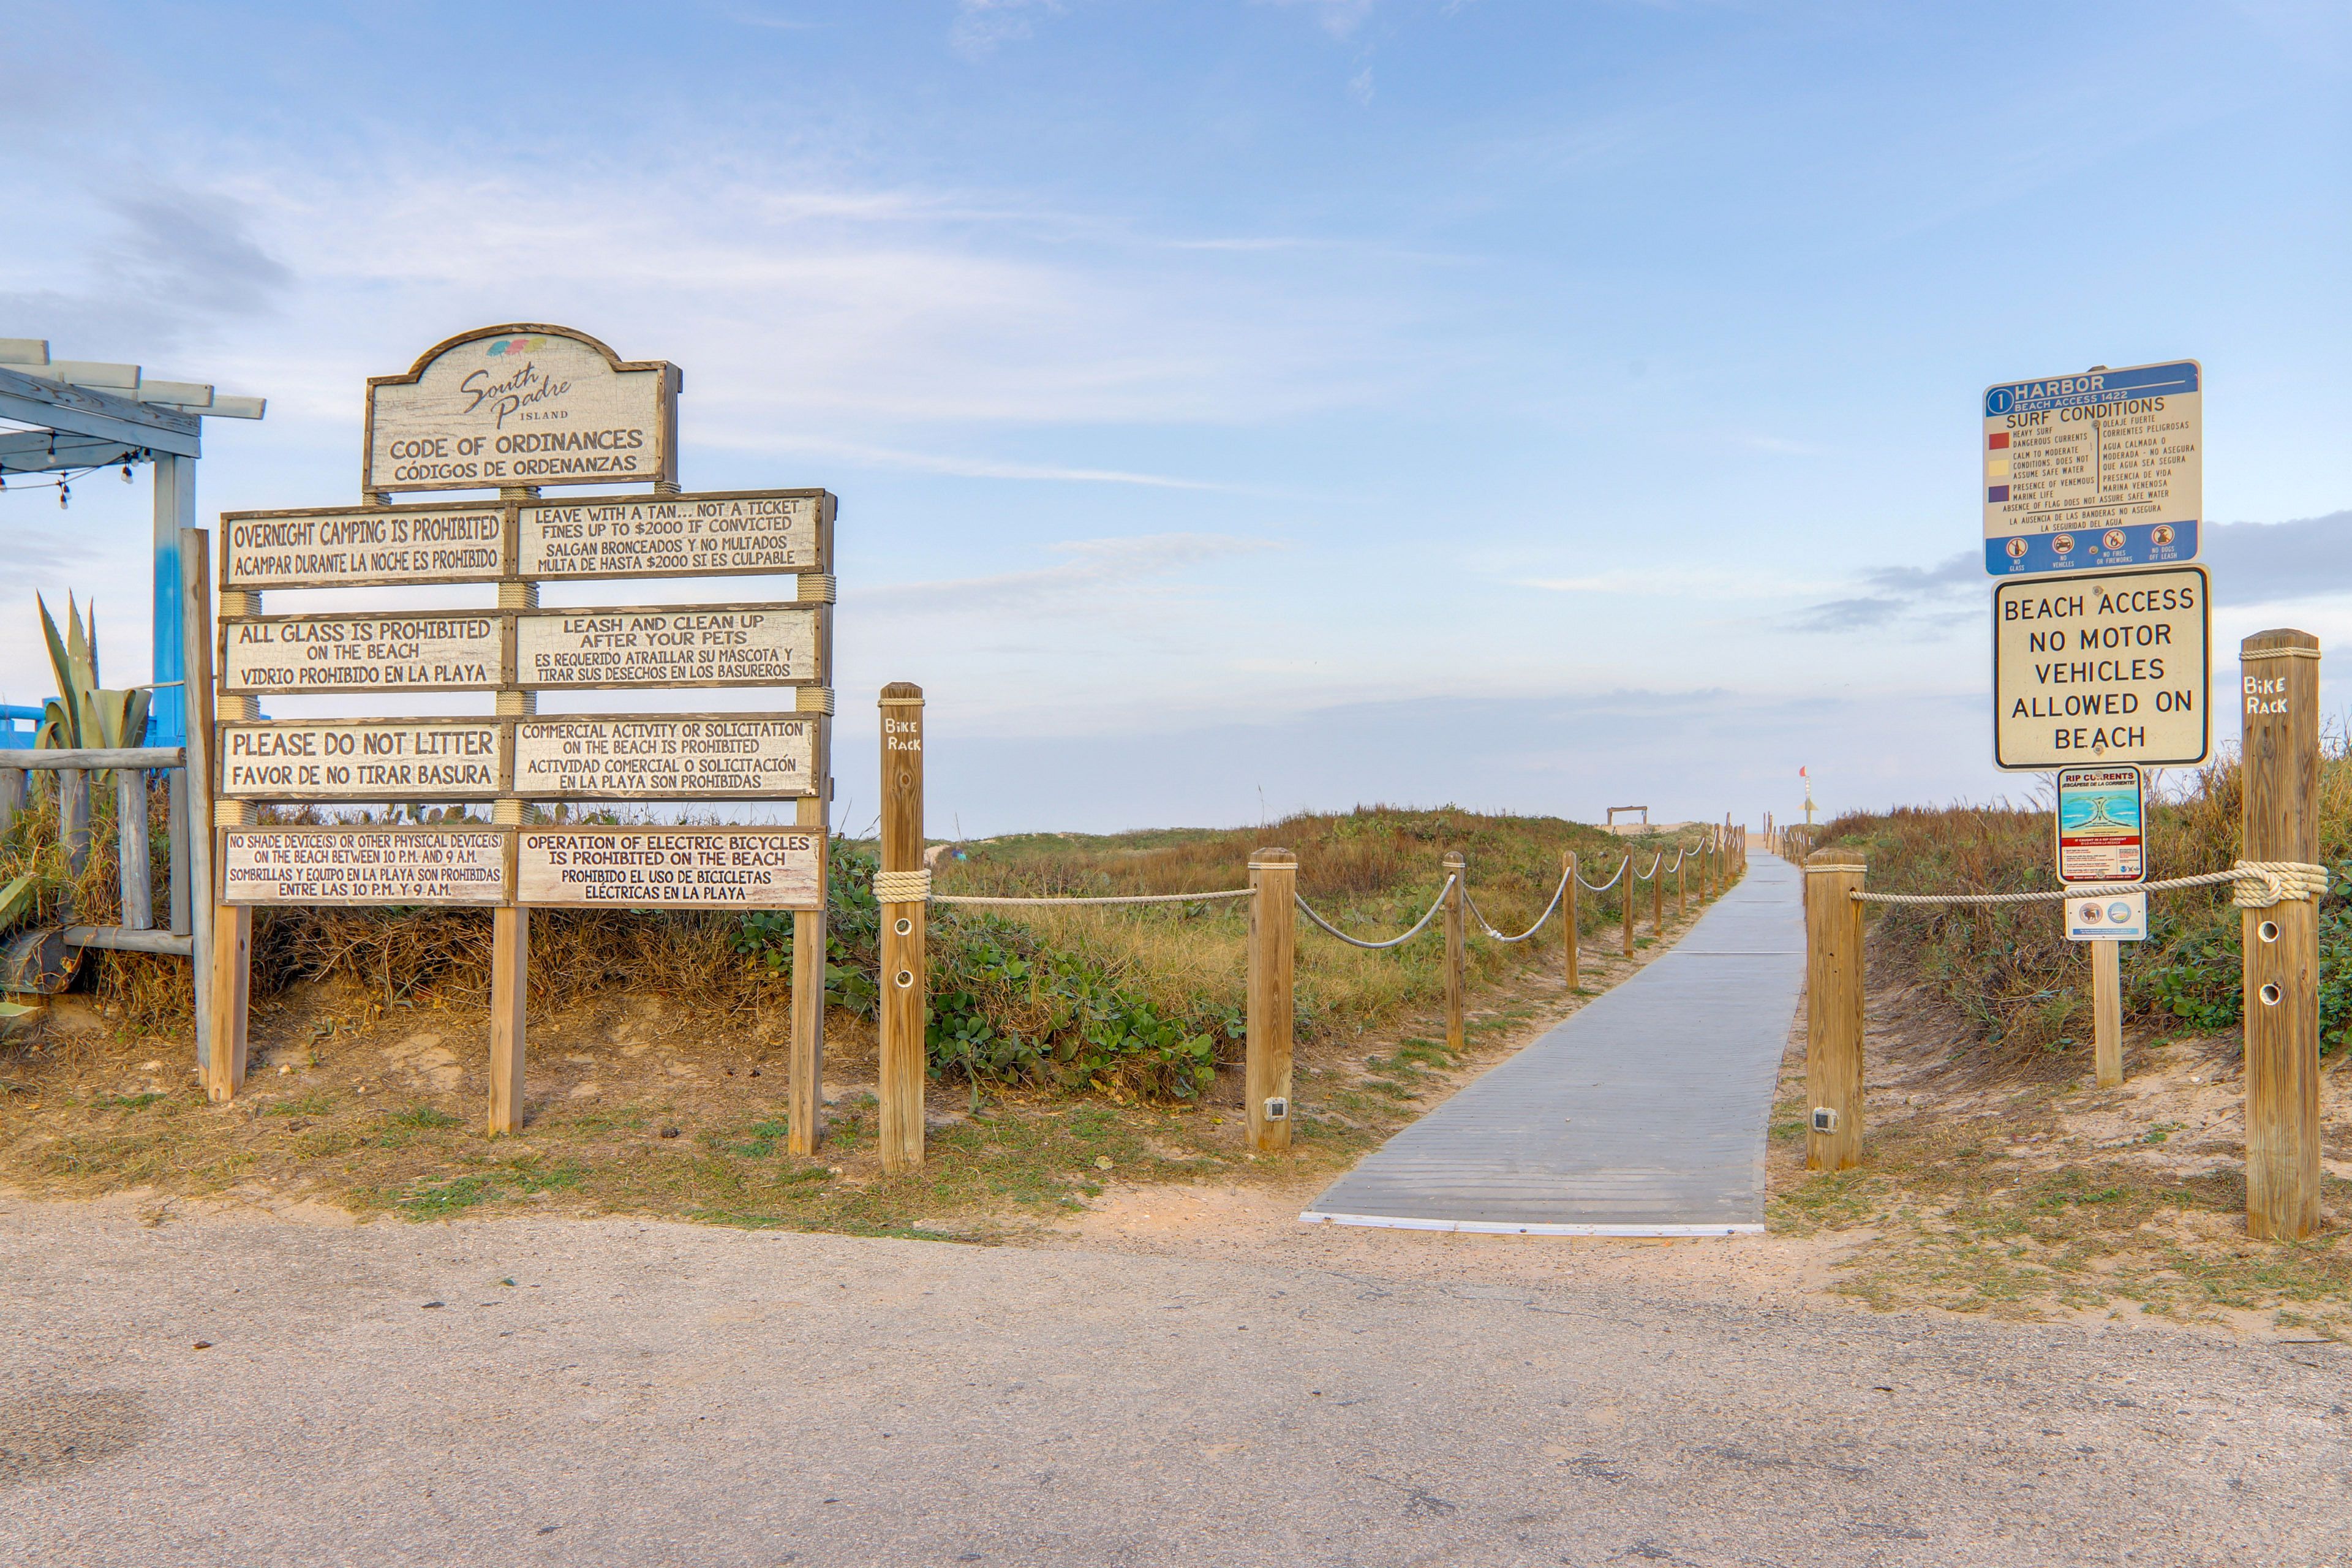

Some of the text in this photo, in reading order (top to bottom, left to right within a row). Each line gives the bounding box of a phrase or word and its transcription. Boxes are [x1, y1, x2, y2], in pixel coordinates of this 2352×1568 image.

[461, 361, 538, 413] South
[2015, 375, 2104, 400] HARBOR
[491, 375, 571, 429] Padre
[1999, 394, 2003, 409] 1
[2015, 391, 2128, 412] BEACH ACCESS 1422
[520, 411, 567, 421] ISLAND
[2007, 397, 2165, 428] SURF CONDITIONS
[2103, 415, 2155, 428] OLEAJE FUERTE
[2103, 421, 2188, 437] CORRIENTES PELIGROSAS
[2037, 426, 2052, 435] SURF
[391, 429, 642, 460] CODE OF ORDINANCES
[2013, 432, 2087, 448] DANGEROUS CURRENTS
[2125, 439, 2157, 448] CALMADA
[2045, 446, 2079, 456] MODERATE
[2103, 450, 2139, 460] MODERADA
[2163, 445, 2195, 454] ASEGURA
[394, 455, 636, 481] CÓDIGOS DE ORDENANZAS
[2160, 455, 2185, 465] SEGURA
[2013, 466, 2084, 479] ASSUME SAFE WATER
[2103, 472, 2139, 482] PRESENCIA
[2013, 481, 2045, 491] PRESENCE
[2061, 477, 2094, 486] VENEMOUS
[2133, 480, 2168, 489] VENENOSA
[2003, 503, 2030, 512] ABSENCE
[2100, 494, 2124, 503] ASSURE
[2013, 492, 2036, 501] MARINE
[2021, 514, 2051, 524] AUSENCIA
[2082, 509, 2115, 519] BANDERAS
[2132, 505, 2161, 514] ASEGURA
[235, 515, 499, 548] OVERNIGHT CAMPING IS PROHIBITED
[2053, 522, 2086, 531] SEGURIDAD
[235, 549, 497, 576] ACAMPAR DURANTE LA NOCHE ES PROHIBIDO
[2005, 587, 2194, 620] BEACH ACCESS
[239, 620, 491, 643] ALL GLASS IS PROHIBITED
[564, 615, 764, 633] LEASH AND CLEAN UP
[580, 631, 747, 648] AFTER YOUR PETS
[2030, 624, 2172, 652] NO MOTOR
[307, 643, 419, 660] ON THE BEACH
[241, 665, 486, 685] VIDRIO PROHIBIDO EN LA PLAYA
[2035, 658, 2165, 684] VEHICLES
[2012, 690, 2192, 718] ALLOWED ON
[233, 731, 493, 756] PLEASE DO NOT LITTER
[2055, 726, 2145, 749] BEACH
[233, 765, 491, 785] FAVOR DE NO TIRAR BASURA
[2084, 772, 2134, 781] CURENTS
[527, 836, 809, 850] OPERATION OF ELECTRIC BICYCLES
[549, 851, 785, 866] IS PROHIBITED ON THE BEACH
